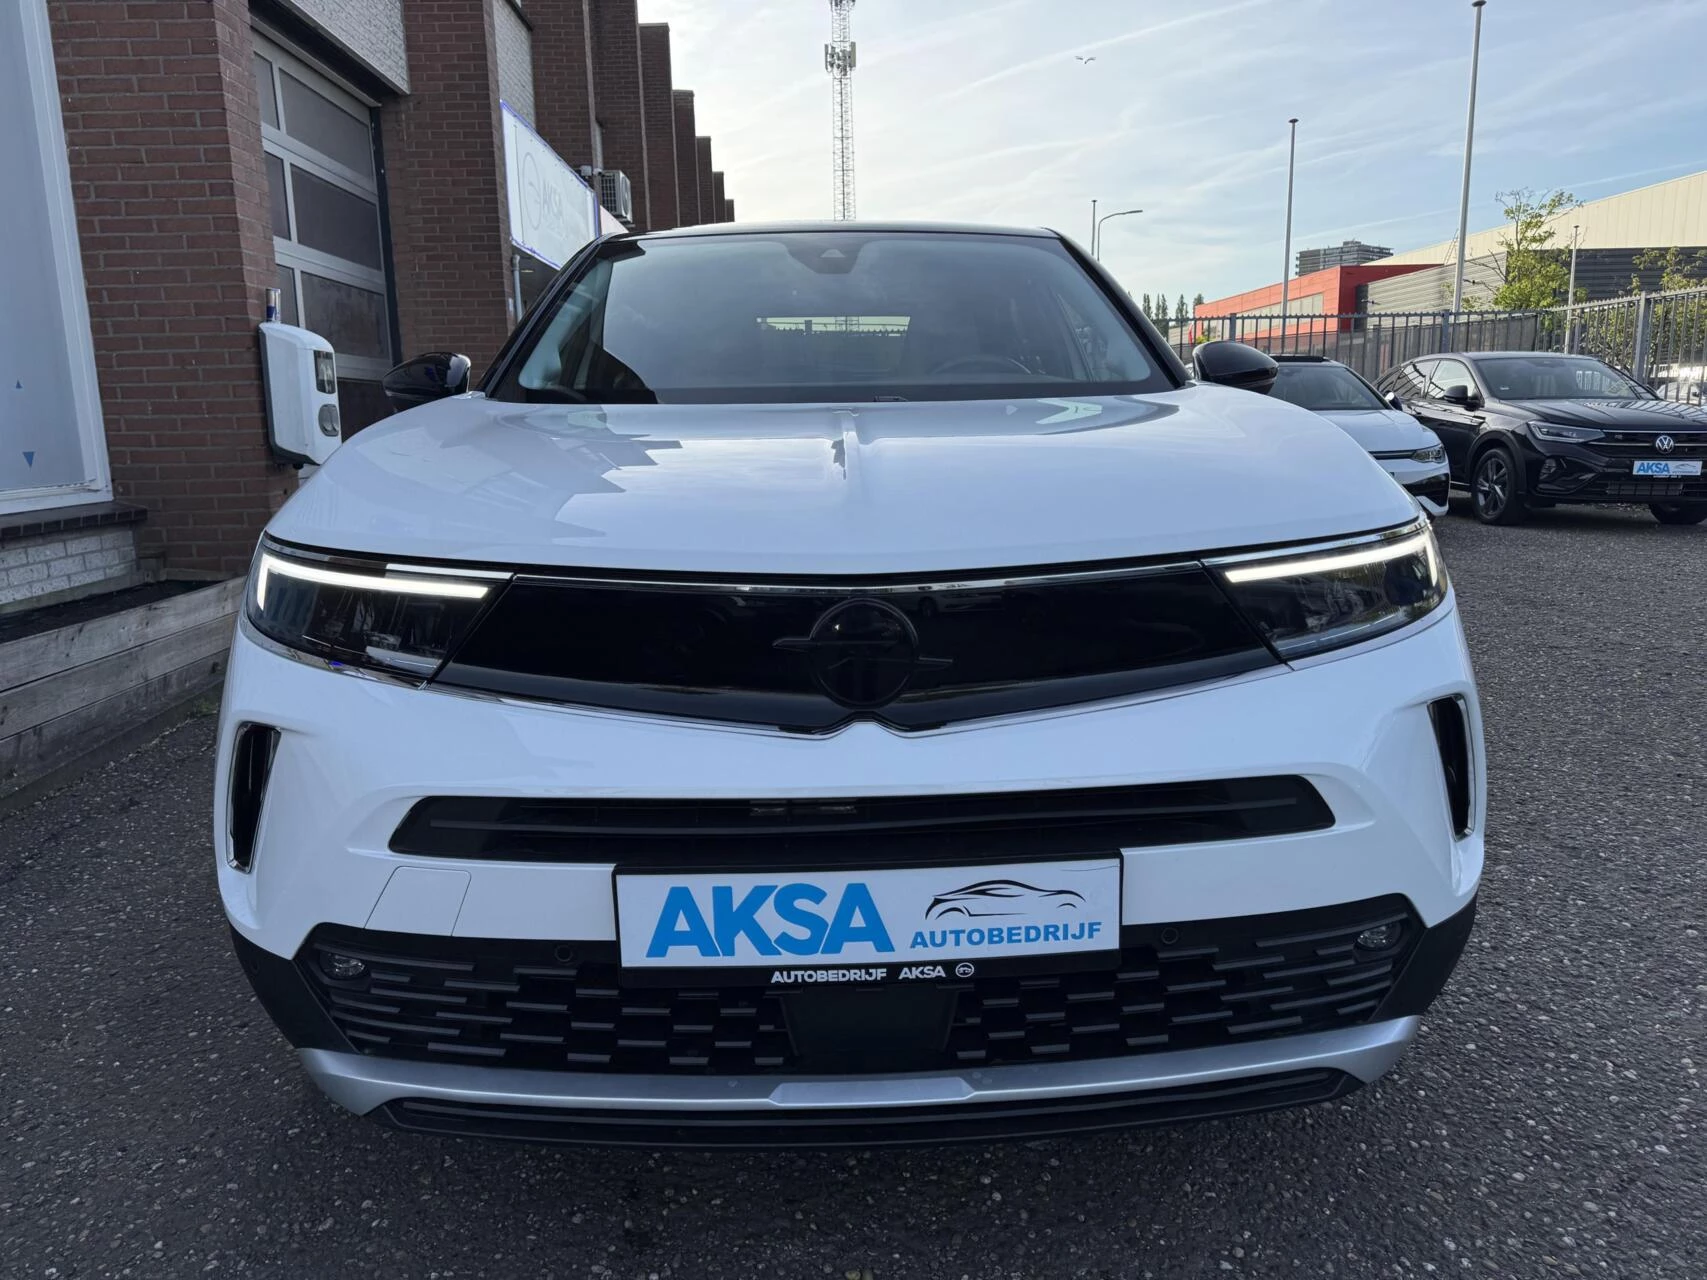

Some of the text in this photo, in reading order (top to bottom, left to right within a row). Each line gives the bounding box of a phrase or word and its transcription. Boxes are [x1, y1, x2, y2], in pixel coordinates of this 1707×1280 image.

[1636, 462, 1670, 474] AKSA
[645, 882, 896, 958] AKSA
[909, 921, 1103, 950] AUTOBEDRIJF
[771, 965, 946, 984] AUTOBEDRIJF AKSA
